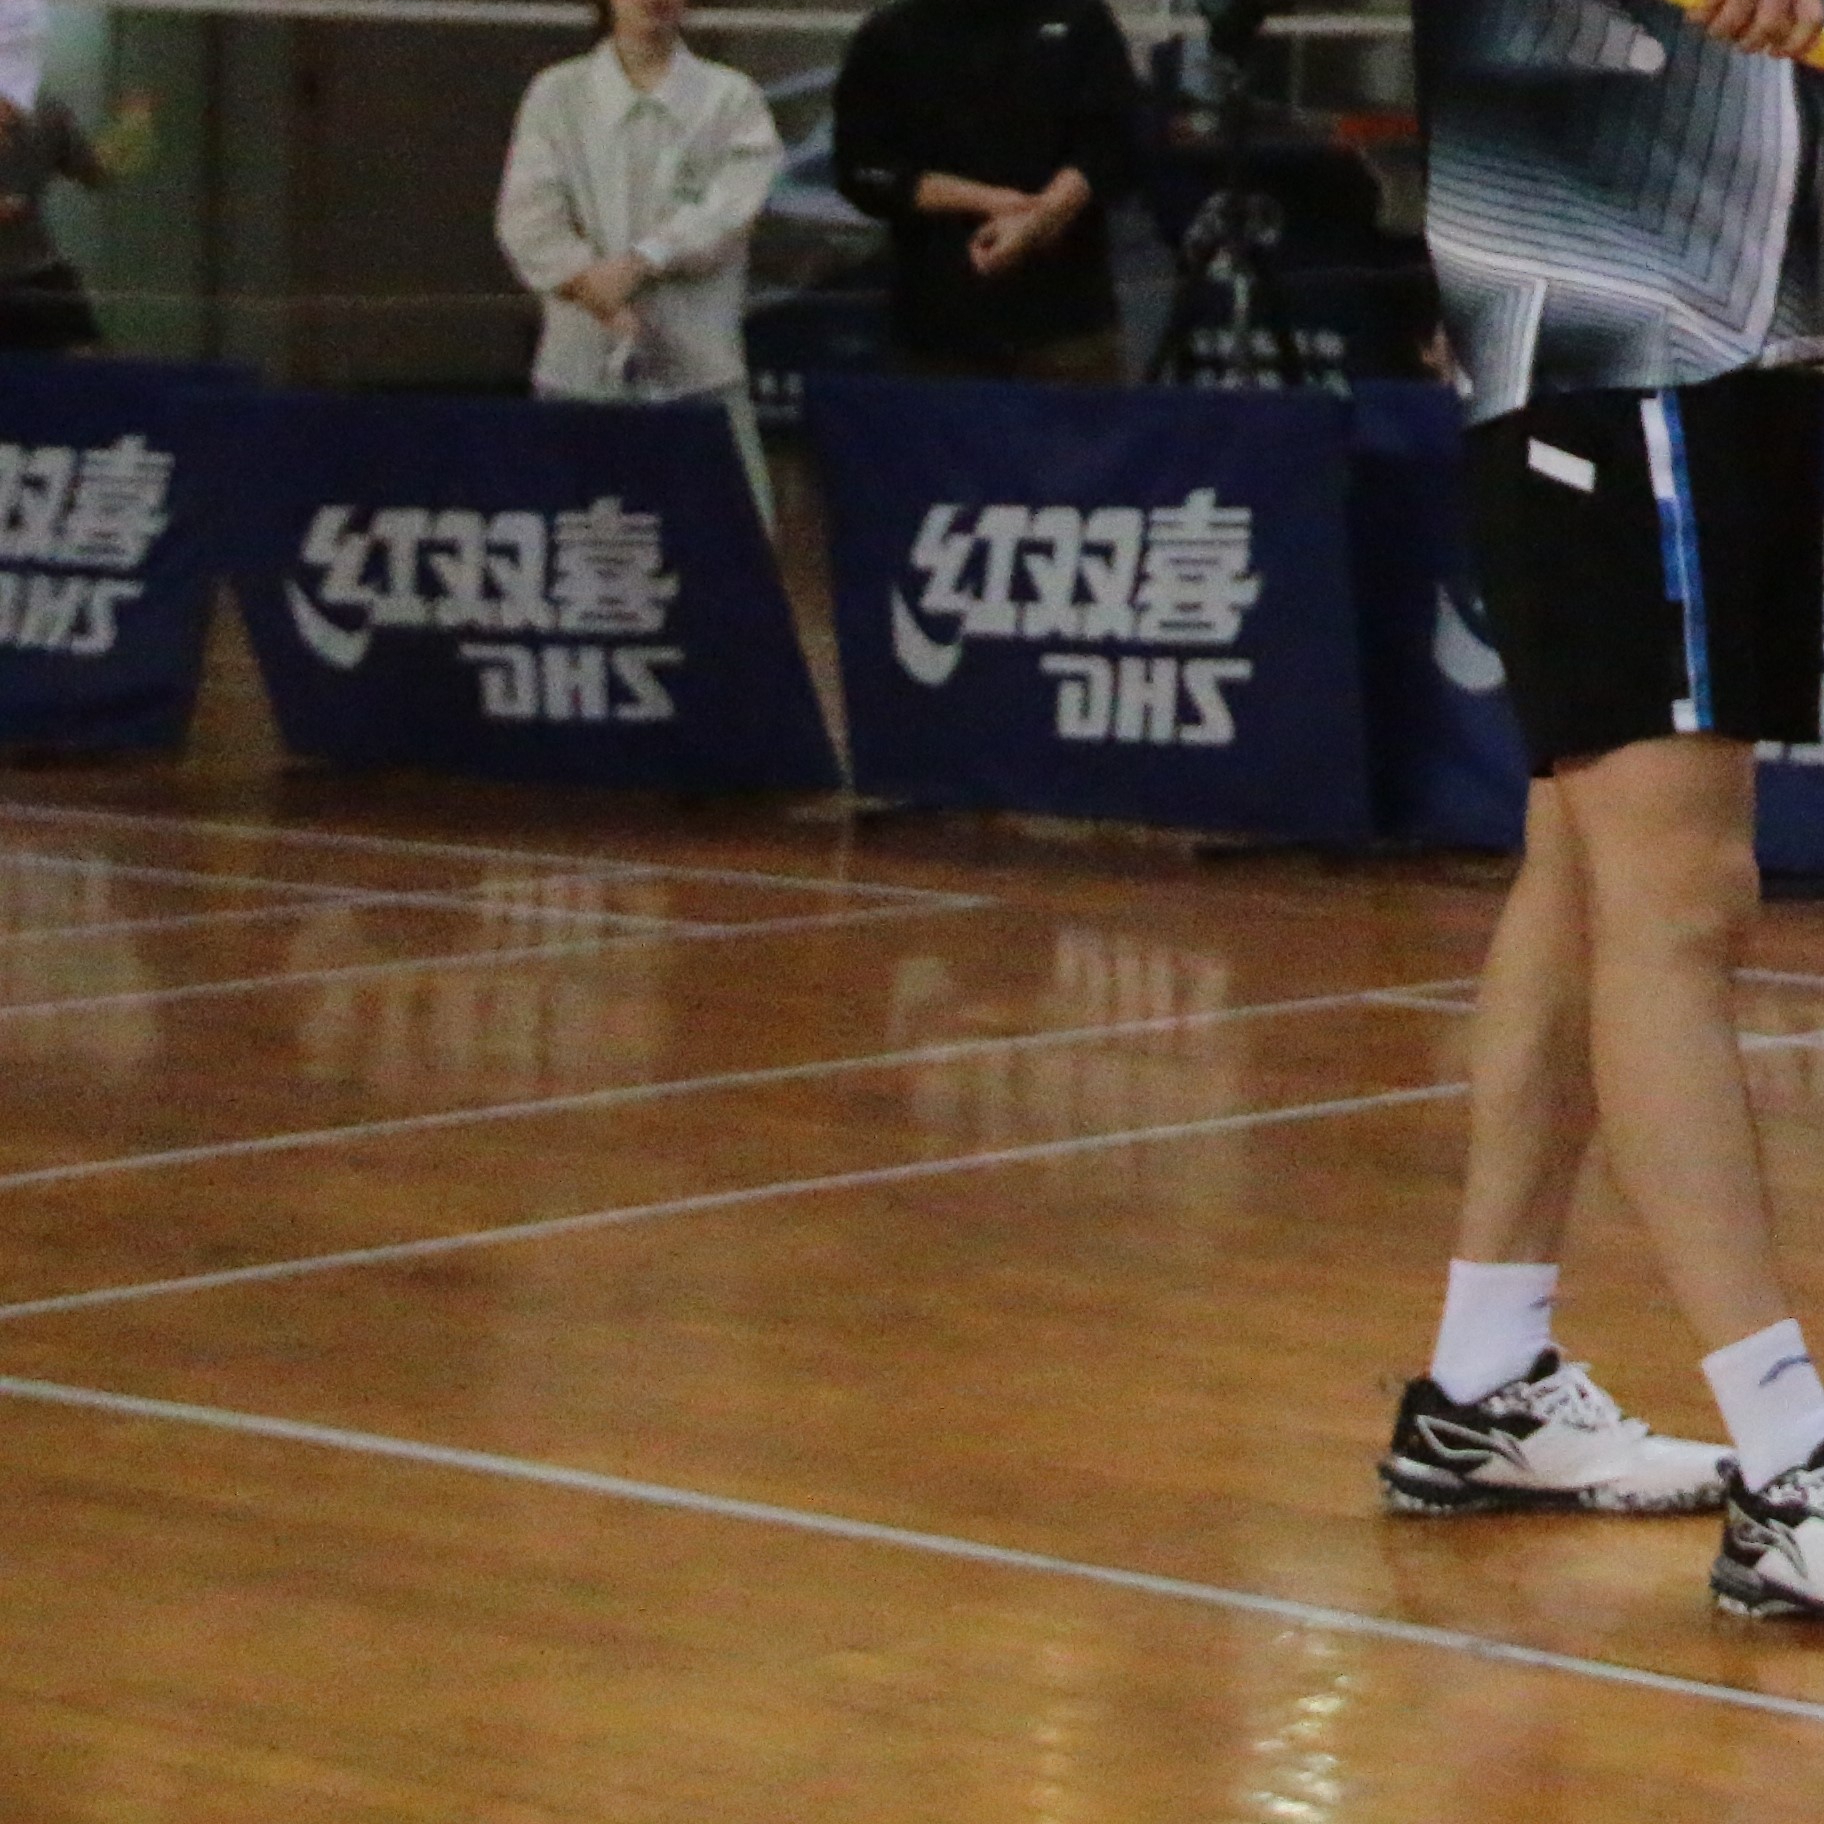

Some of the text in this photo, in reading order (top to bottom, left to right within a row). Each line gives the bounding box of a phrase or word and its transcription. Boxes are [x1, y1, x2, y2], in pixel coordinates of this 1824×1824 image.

[0, 433, 175, 570] 双喜
[0, 572, 145, 656] HS
[284, 495, 680, 669] 红双喜
[890, 487, 1262, 687] 红双喜
[456, 642, 686, 721] DHS
[1039, 652, 1253, 746] DHS
